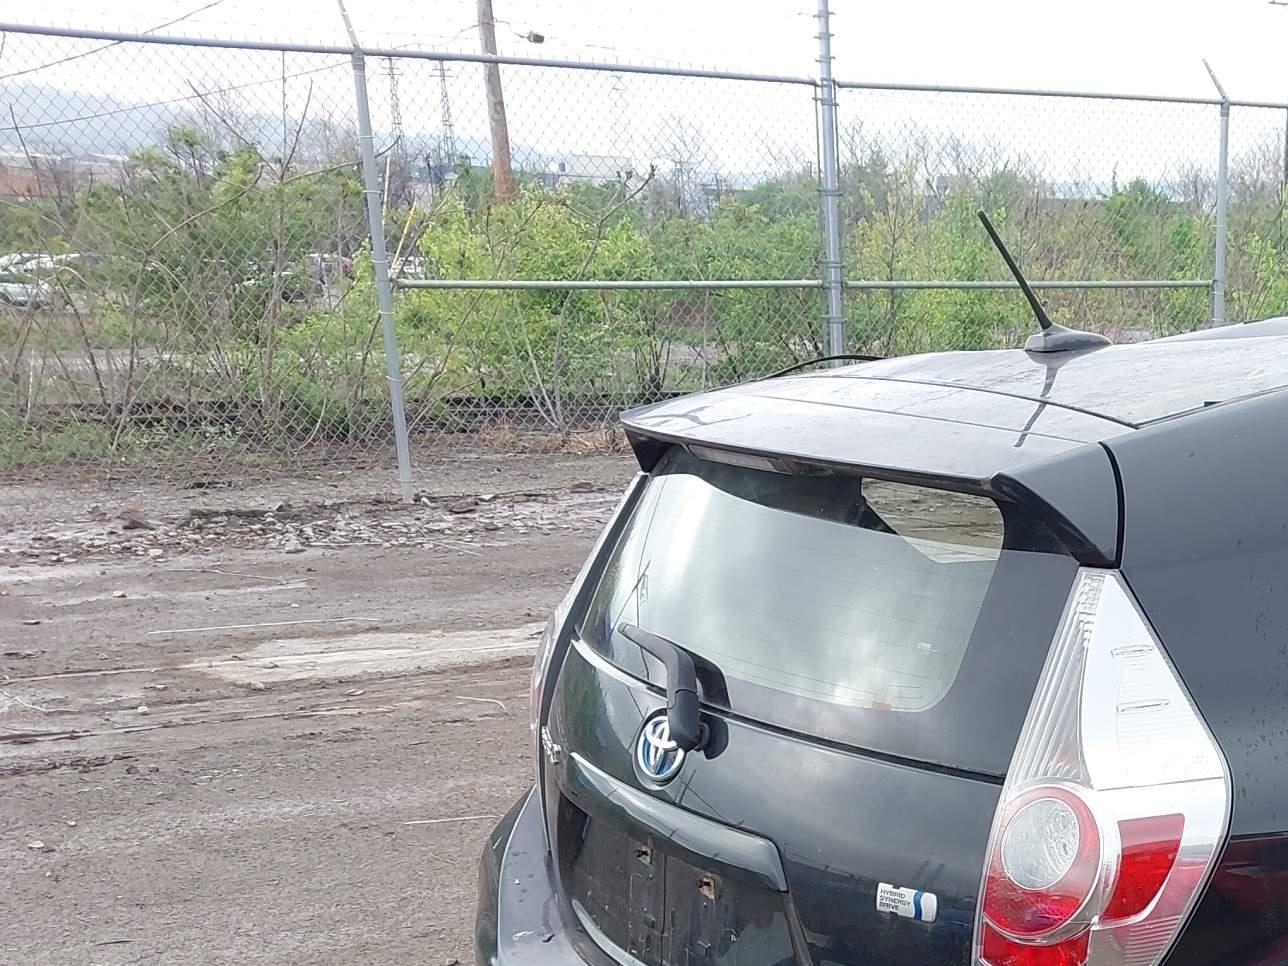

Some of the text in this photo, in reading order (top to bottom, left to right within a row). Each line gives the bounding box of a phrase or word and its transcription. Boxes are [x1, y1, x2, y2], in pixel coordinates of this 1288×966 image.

[880, 888, 906, 899] HYBRID
[879, 895, 911, 907] SYNERGY
[879, 901, 900, 911] DRIVE
